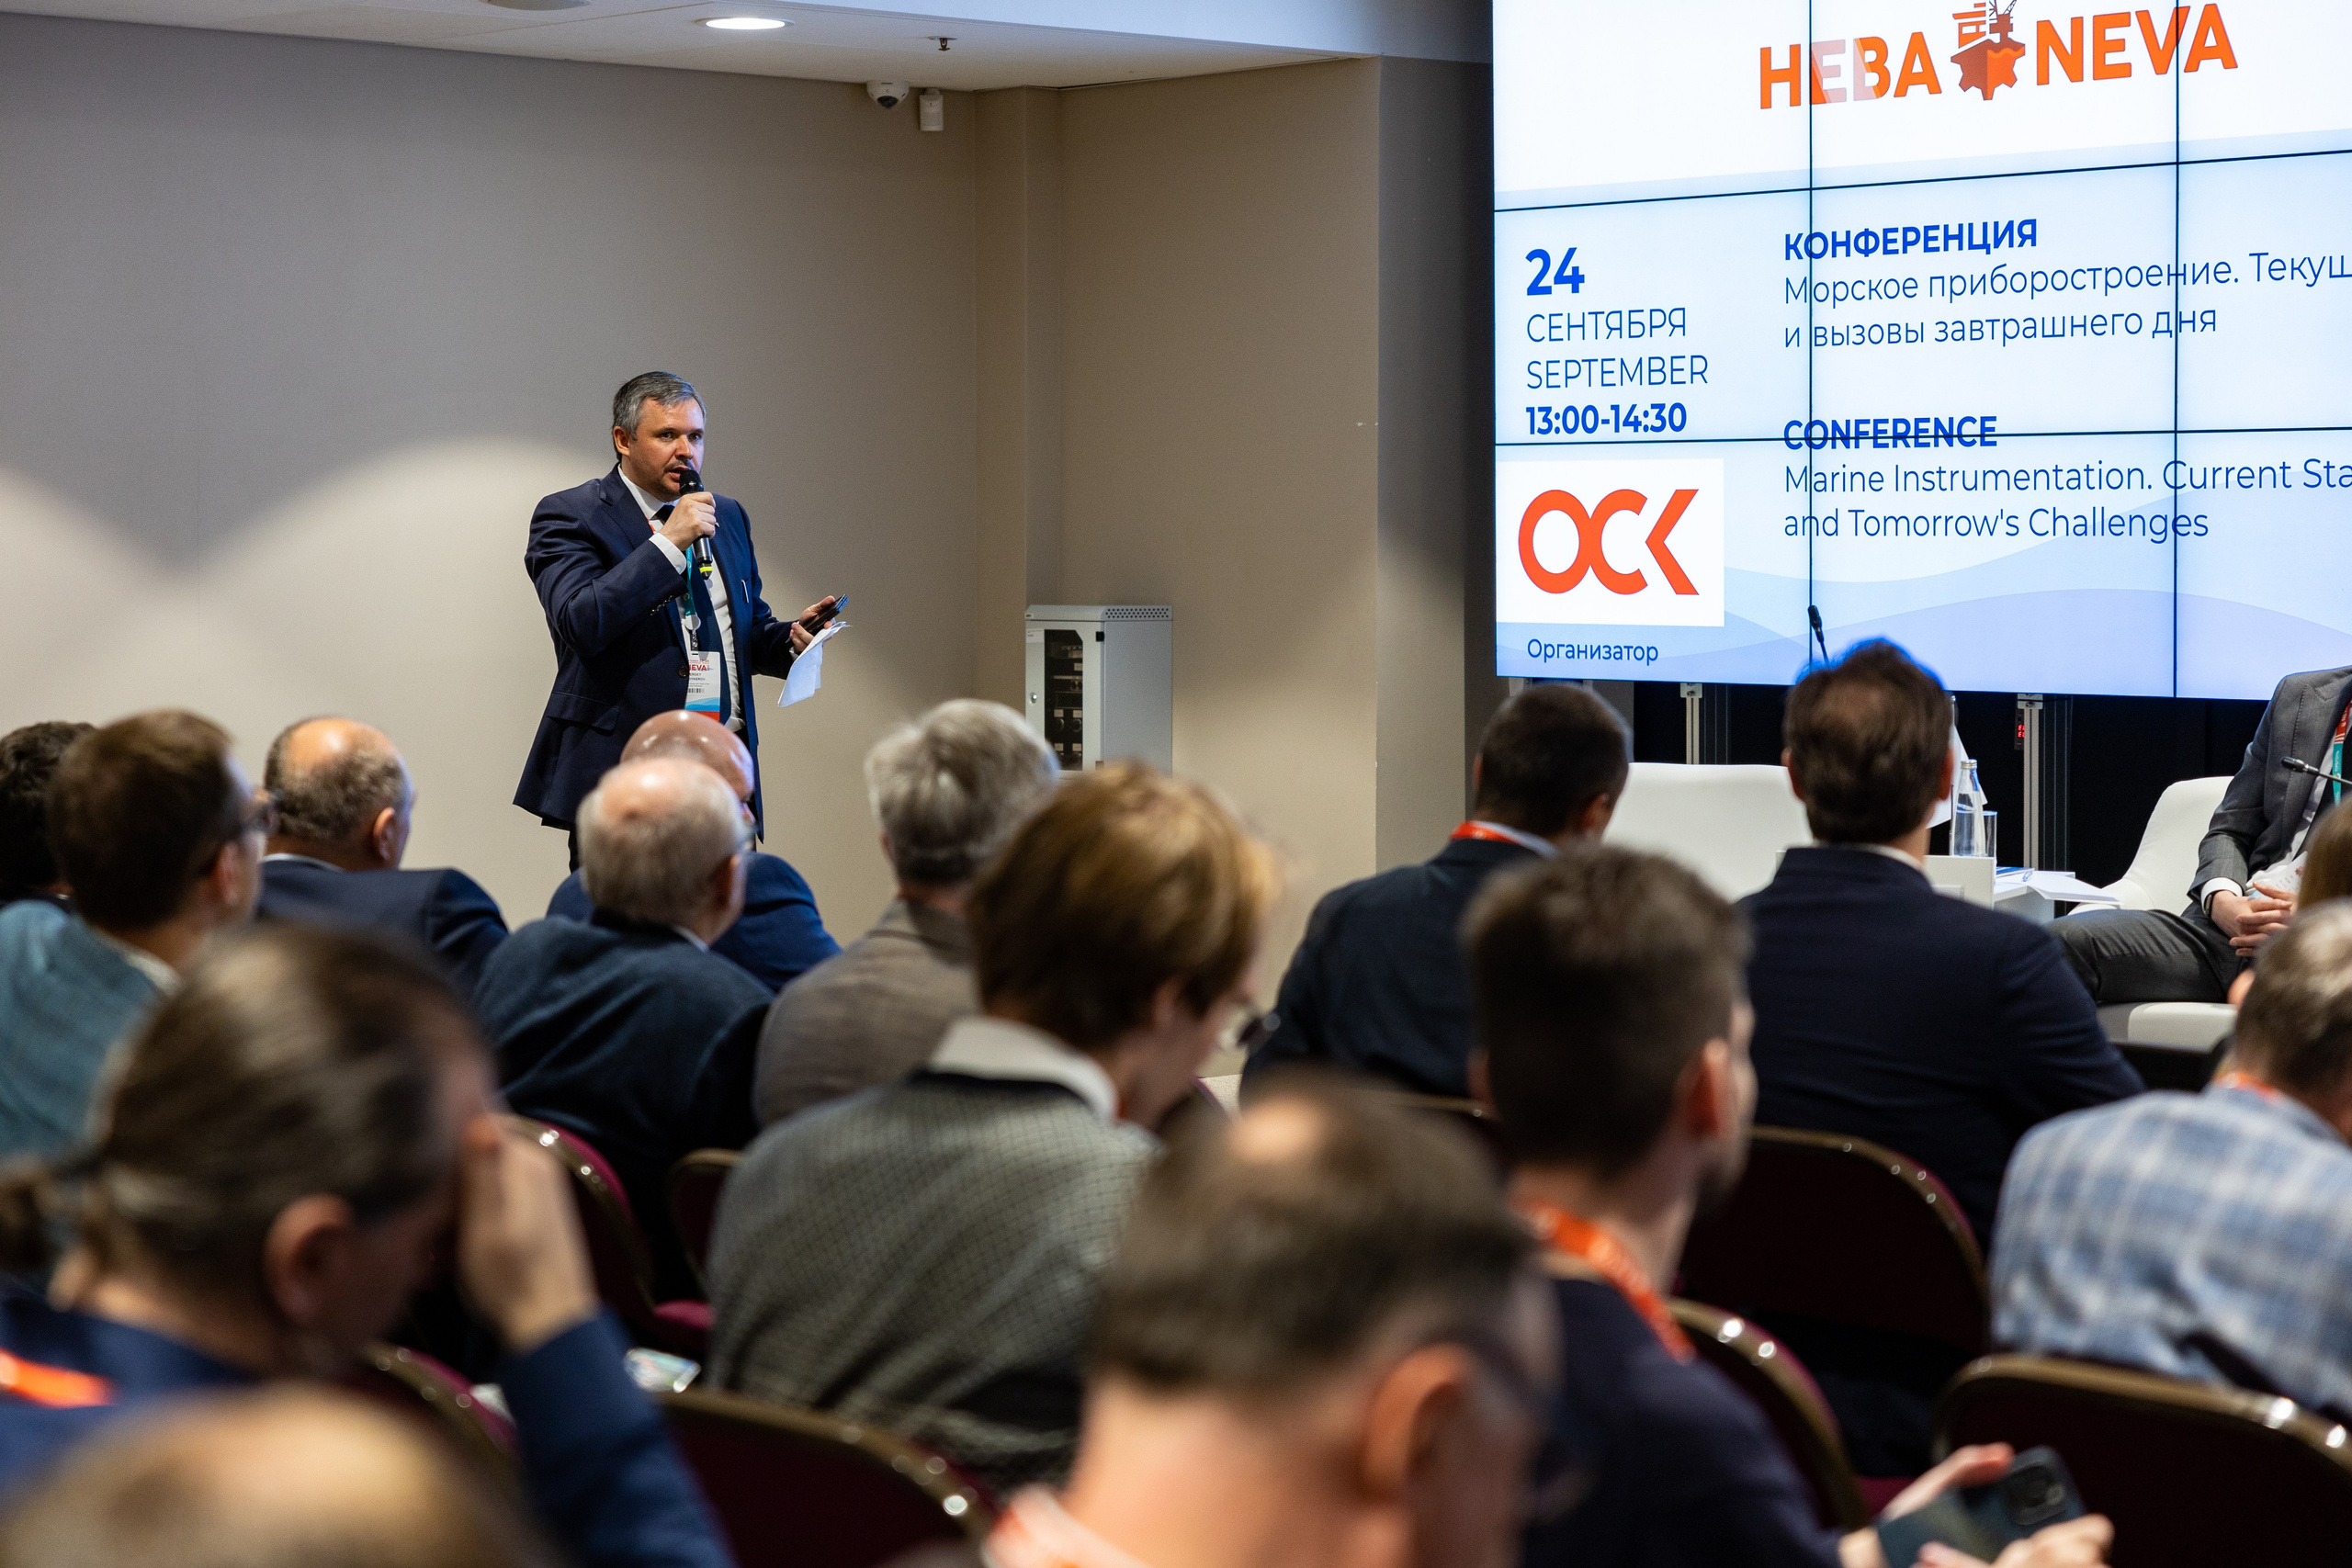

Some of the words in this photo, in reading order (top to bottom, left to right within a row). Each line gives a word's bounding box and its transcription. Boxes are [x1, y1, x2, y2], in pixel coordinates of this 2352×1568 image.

[2037, 4, 2236, 85] NEVA
[1760, 32, 1941, 108] НЕВА
[1786, 219, 2036, 260] КОНФЕРЕНЦИЯ
[1526, 247, 1584, 296] 24
[1786, 276, 1917, 309] Морское
[1930, 261, 2238, 304] приборостроение.
[1528, 308, 1685, 342] СЕНТЯБРЯ
[1786, 328, 1799, 347] и
[1815, 322, 1923, 346] вызовы
[1935, 313, 2142, 346] завтрашнего
[2153, 310, 2215, 339] дня
[1528, 355, 1707, 389] SEPTEMBER
[1526, 403, 1686, 434] 13:00-14:30
[1784, 416, 1997, 449] CONFERENCE
[1787, 464, 1883, 492] Marine
[1896, 460, 2152, 491] Instrumentation.
[2164, 458, 2291, 491] Current
[2303, 458, 2352, 488] Sta
[1785, 508, 1838, 536] and
[1849, 509, 2018, 536] Tomorrow's
[2030, 507, 2208, 544] Challenges
[1528, 639, 1658, 666] Организатор
